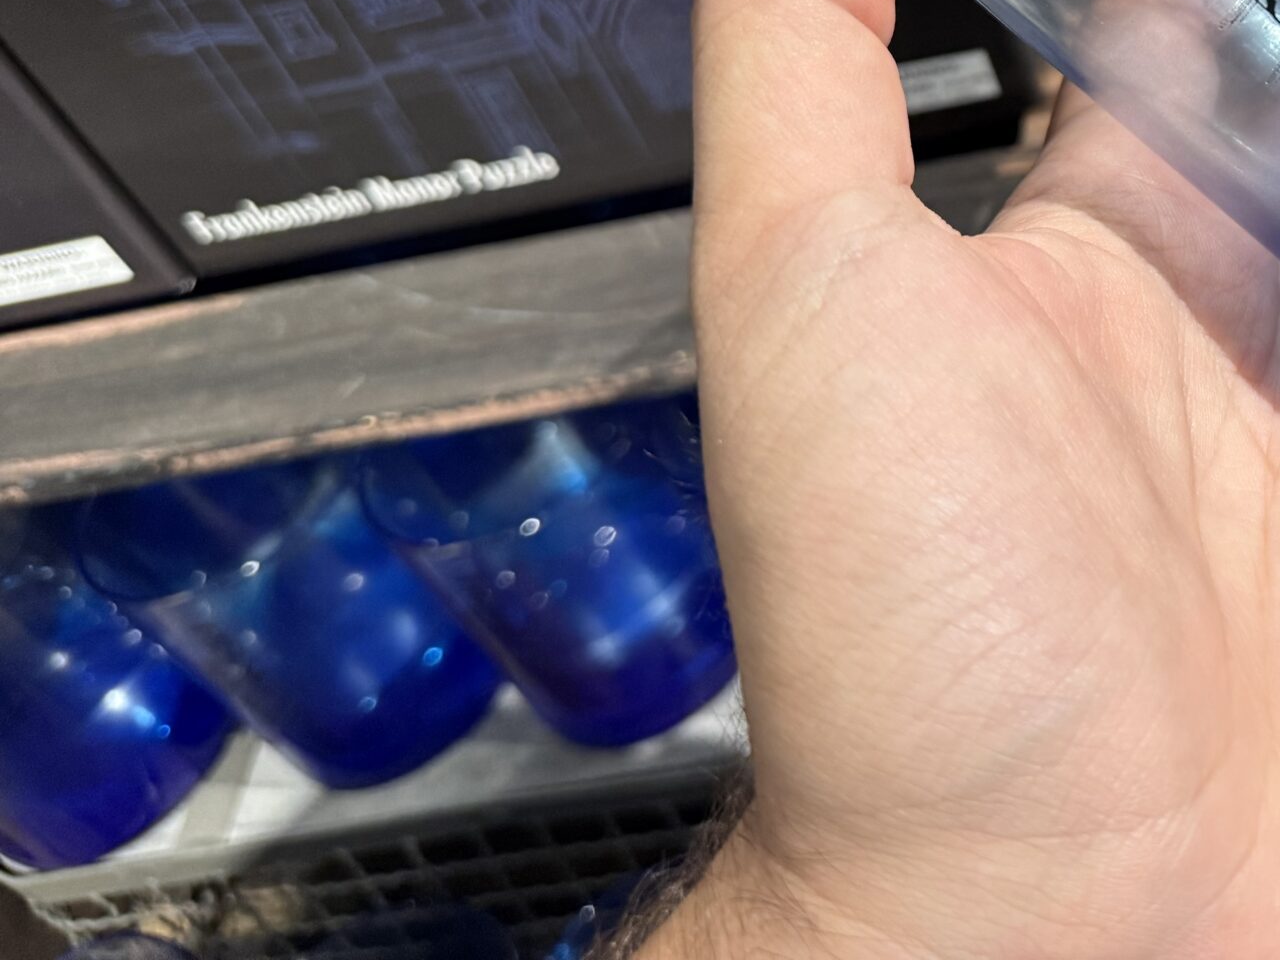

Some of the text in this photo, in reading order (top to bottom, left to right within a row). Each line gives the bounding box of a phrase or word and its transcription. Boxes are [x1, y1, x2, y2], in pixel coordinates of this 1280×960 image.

[181, 145, 560, 245] Frankenstein Manor Puzzle
